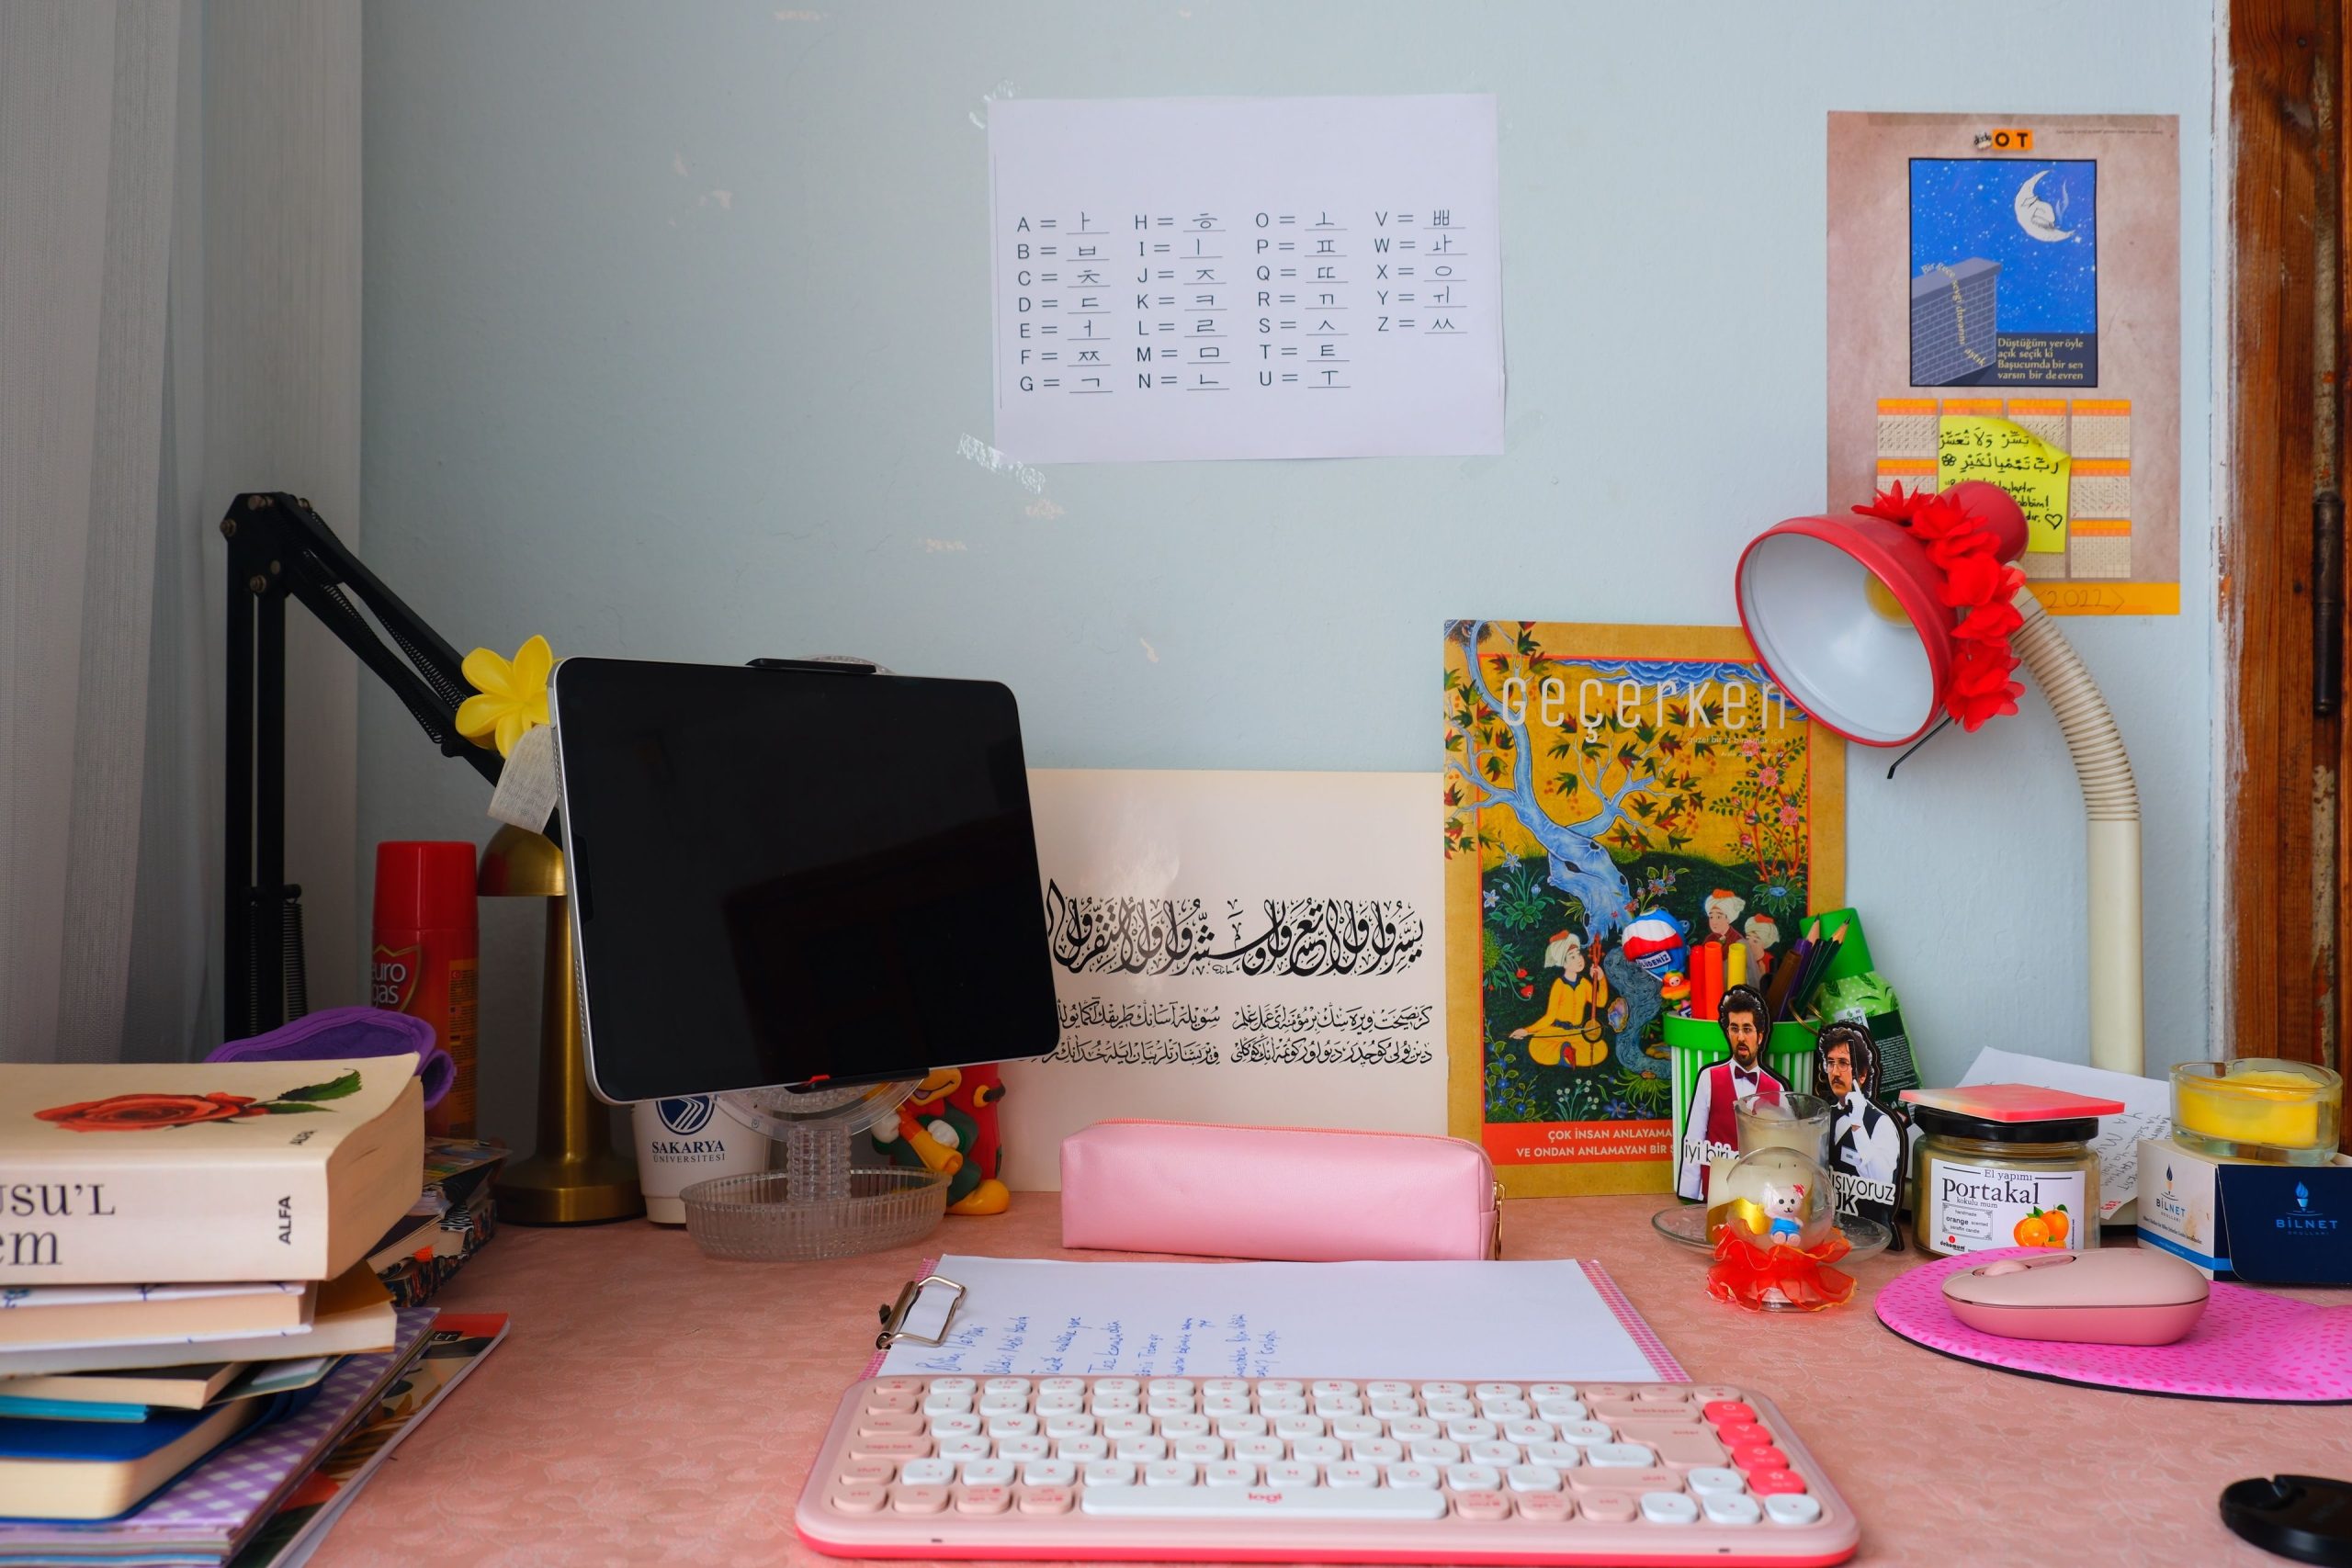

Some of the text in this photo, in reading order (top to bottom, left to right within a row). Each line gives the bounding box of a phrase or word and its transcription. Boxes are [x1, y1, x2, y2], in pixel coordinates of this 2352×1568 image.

[1017, 217, 1031, 232] A
[1136, 214, 1148, 230] H
[1256, 213, 1270, 228] O
[1375, 211, 1388, 227] V
[1018, 244, 1030, 259] B
[1140, 242, 1145, 256] I
[1257, 239, 1269, 254] P
[1374, 238, 1390, 254] W
[1018, 271, 1032, 286] C
[1137, 268, 1148, 283] J
[1257, 265, 1271, 281] Q
[1377, 265, 1388, 279] X
[1019, 298, 1032, 312] D
[1137, 294, 1149, 309] K
[1259, 292, 1271, 307] R
[1377, 290, 1389, 305] Y
[1020, 323, 1032, 338] E
[1139, 321, 1150, 335] L
[1260, 318, 1271, 333] S
[1378, 317, 1390, 332] Z
[1260, 344, 1272, 359] T
[1997, 337, 2084, 351] Düştüğüm yer öyle
[1022, 350, 1032, 365] F
[1137, 346, 1151, 362] M
[1997, 348, 2053, 360] açık seçik ki
[1997, 359, 2051, 370] Başucumda
[2052, 359, 2065, 368] bir
[1139, 373, 1151, 389] N
[1260, 371, 1272, 386] U
[2029, 369, 2042, 379] bir
[2046, 369, 2057, 379] de
[1020, 376, 1034, 391] G
[1503, 677, 1785, 743] Geçerken
[1548, 1130, 1571, 1144] ÇOK
[1575, 1127, 1610, 1140] İNSAN
[651, 1140, 725, 1154] SAKARYA
[1516, 1147, 1531, 1157] VE
[1533, 1146, 1574, 1156] ONDAN
[1577, 1145, 1646, 1156] ANLAMAYAN
[1650, 1144, 1667, 1155] BİR
[1685, 1139, 1701, 1163] iyi
[653, 1153, 725, 1163] ÜNİVERSİTESİ
[1984, 1169, 2032, 1181] El yapımı
[1942, 1177, 2040, 1204] Portakal
[1956, 1197, 1978, 1206] kokulu
[2155, 1198, 2185, 1217] BİLNET
[278, 1196, 291, 1246] ALFA
[1946, 1215, 1969, 1225] orange
[2276, 1217, 2337, 1229] BİLNET
[1249, 1492, 1283, 1504] logi
